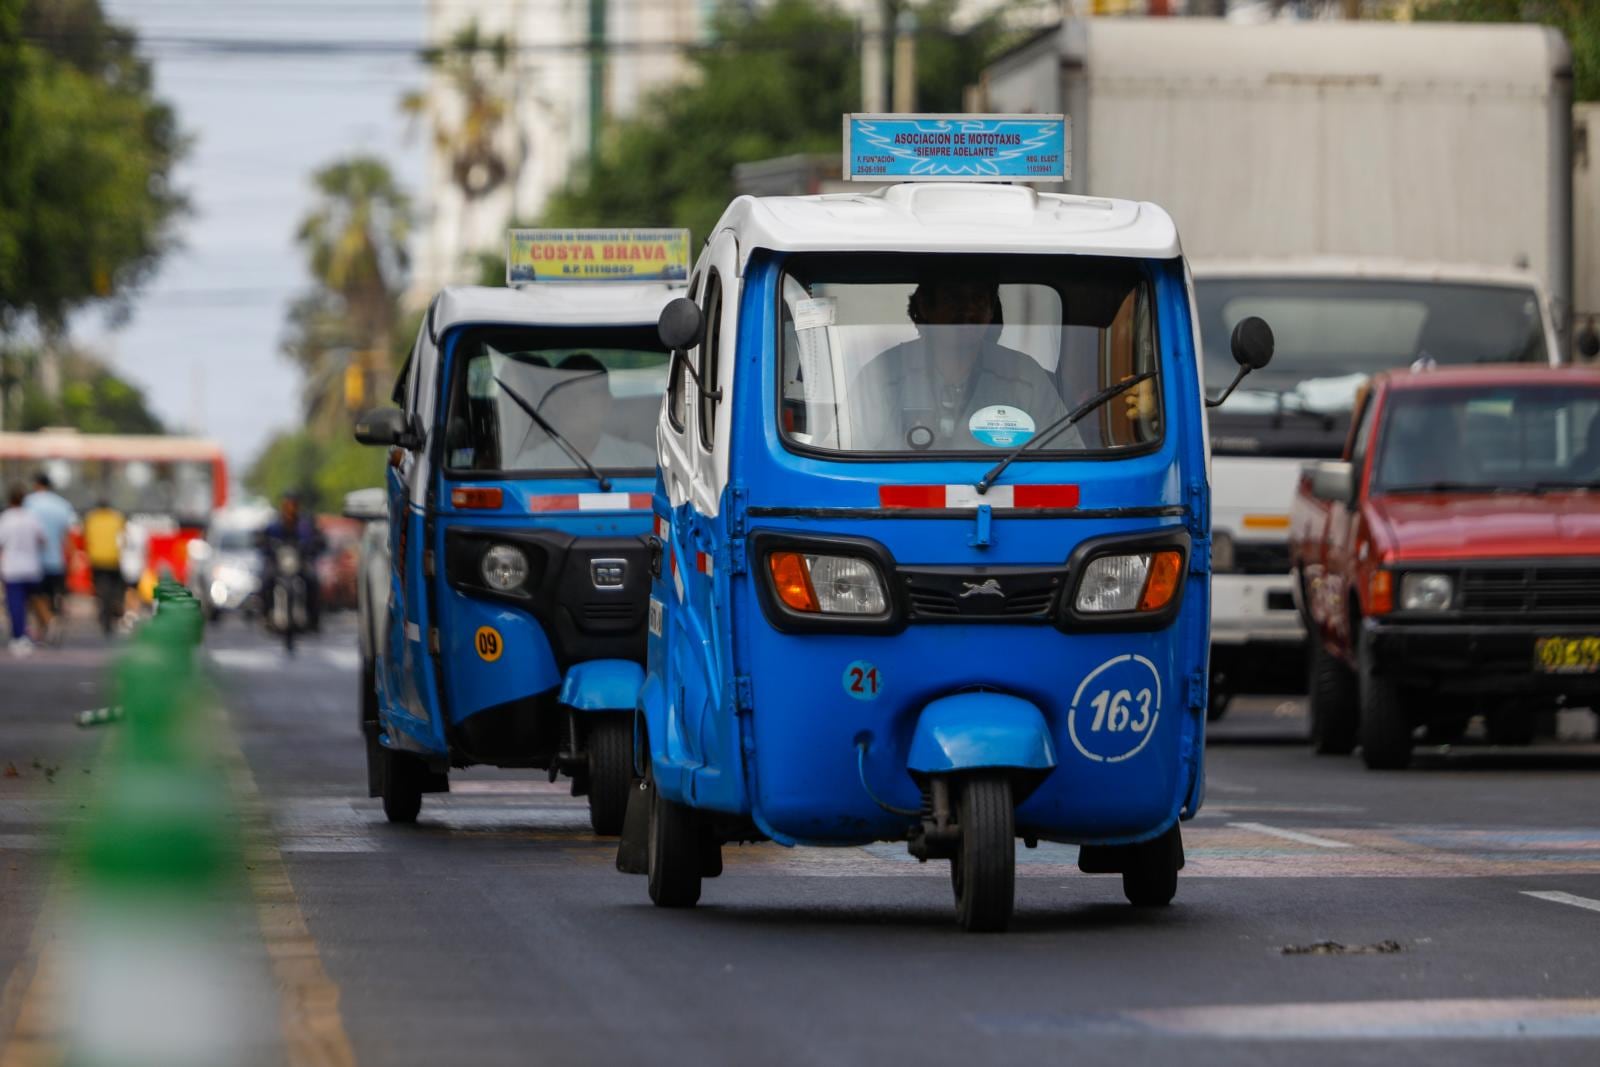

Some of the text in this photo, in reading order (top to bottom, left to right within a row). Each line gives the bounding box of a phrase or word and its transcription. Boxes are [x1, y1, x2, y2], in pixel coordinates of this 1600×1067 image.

[895, 134, 1020, 144] ASOCIACION DE MOTOTAXIS
[530, 243, 666, 260] COSTA BRAVA
[479, 632, 497, 654] 09
[850, 667, 877, 693] 21
[1090, 688, 1151, 732] 163
